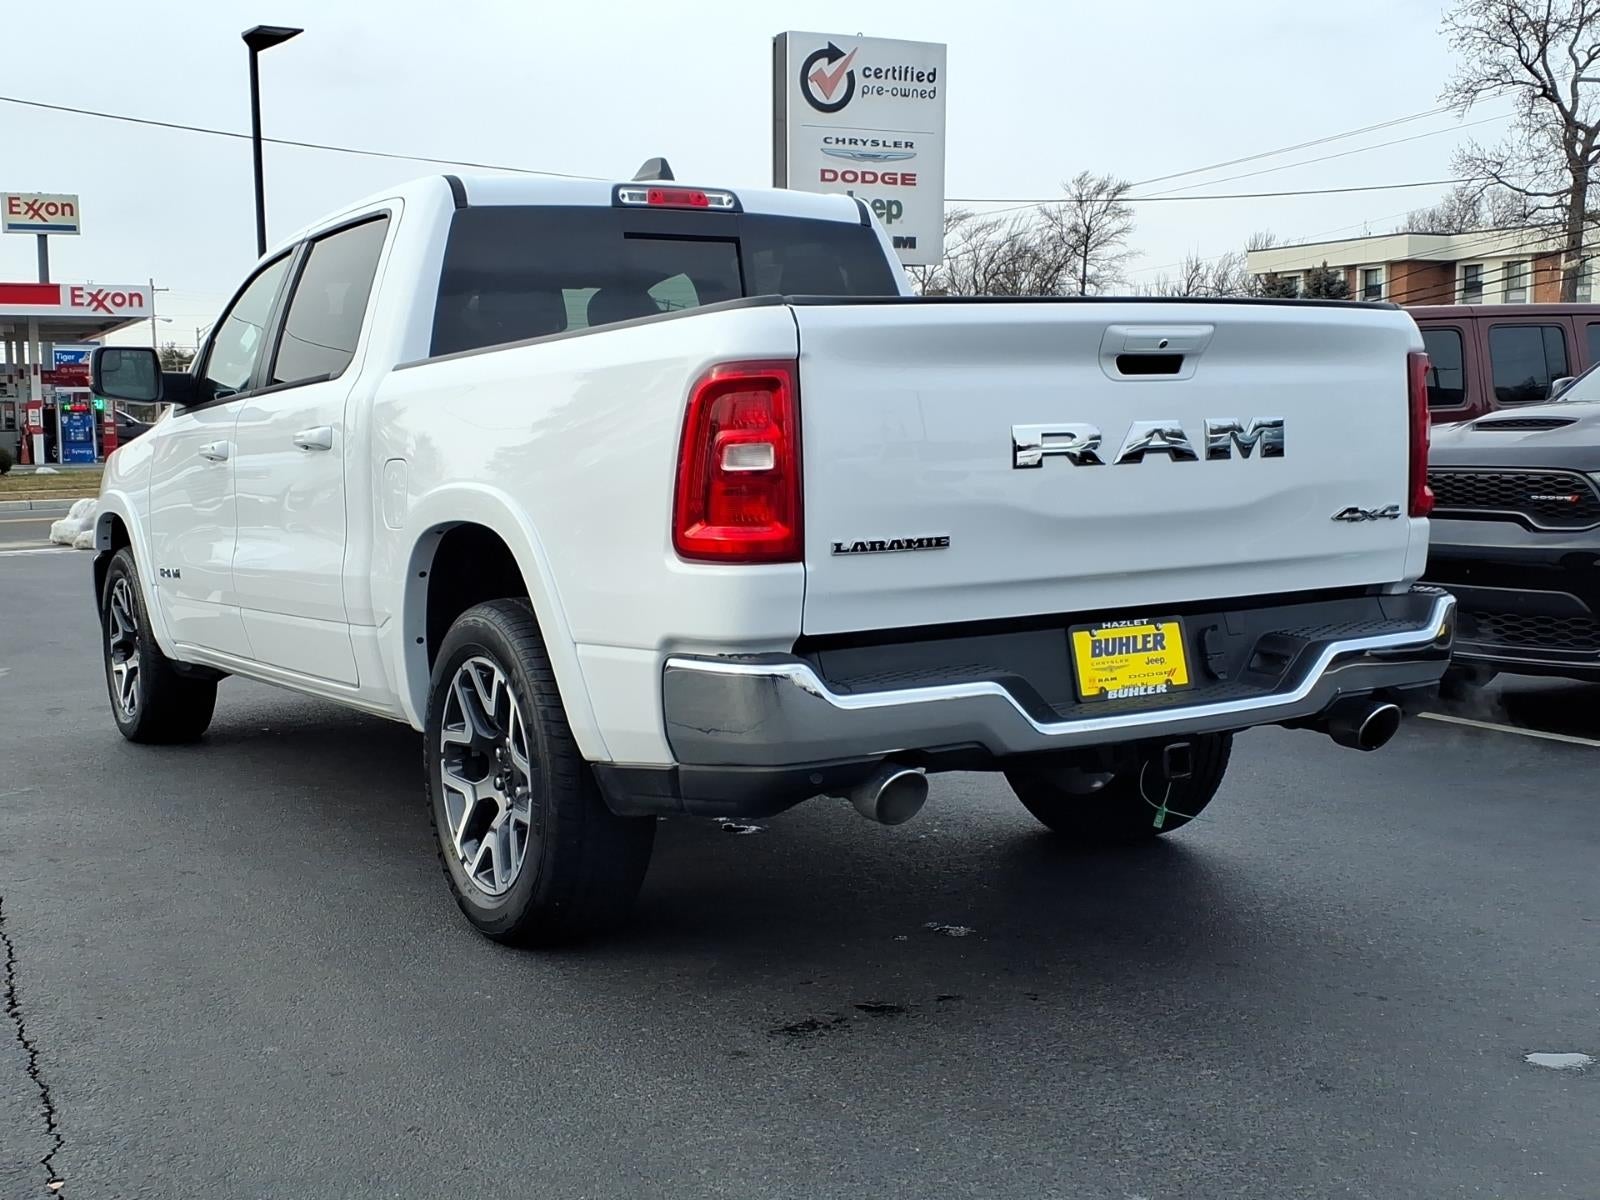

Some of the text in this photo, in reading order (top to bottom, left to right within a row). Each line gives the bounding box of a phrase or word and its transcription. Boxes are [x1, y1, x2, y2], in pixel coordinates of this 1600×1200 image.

[862, 65, 937, 83] certified
[861, 84, 937, 99] pre-owned
[823, 136, 915, 149] CHRYSLER
[820, 168, 917, 186] DODGE
[8, 196, 74, 222] Exxon
[70, 287, 143, 314] Exxon
[56, 352, 75, 361] Tiger
[1012, 417, 1285, 469] RAM
[1331, 504, 1401, 522] 4x4
[832, 536, 951, 555] LARAMIE
[1102, 618, 1149, 629] HAZLET
[1091, 632, 1166, 658] BUHLER
[1145, 657, 1165, 665] Jeep
[1107, 684, 1168, 699] BUHLER
